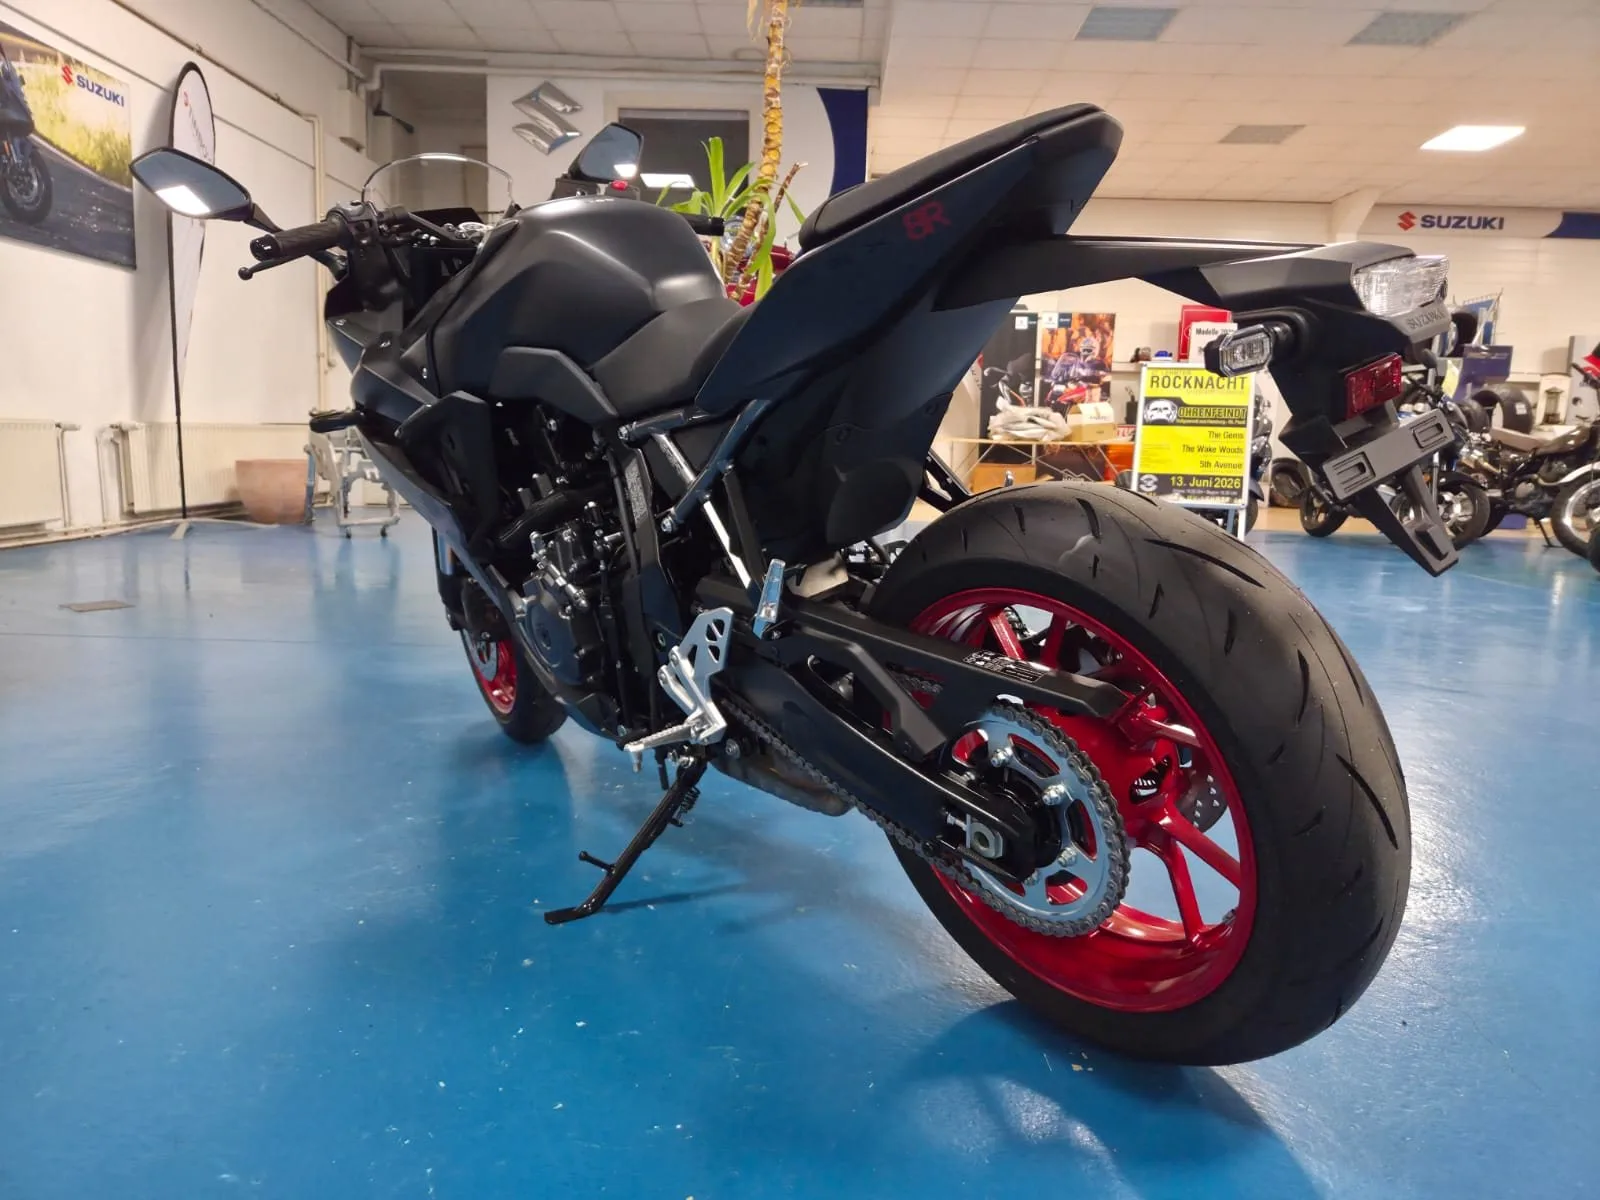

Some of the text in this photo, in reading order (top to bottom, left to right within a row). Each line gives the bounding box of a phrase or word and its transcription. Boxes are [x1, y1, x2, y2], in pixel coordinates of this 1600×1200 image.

[76, 75, 125, 107] SUZUKI
[1420, 214, 1504, 230] SUZUKI
[1195, 327, 1219, 336] Modelle
[1150, 375, 1249, 390] ROCKNACHT
[1177, 406, 1248, 419] OHRENFEINDT
[1208, 430, 1244, 439] The Gems
[1182, 444, 1244, 454] The Wake Woods
[1200, 460, 1242, 469] 5th Avenue
[1169, 476, 1187, 488] 13.
[1190, 476, 1213, 488] Juni
